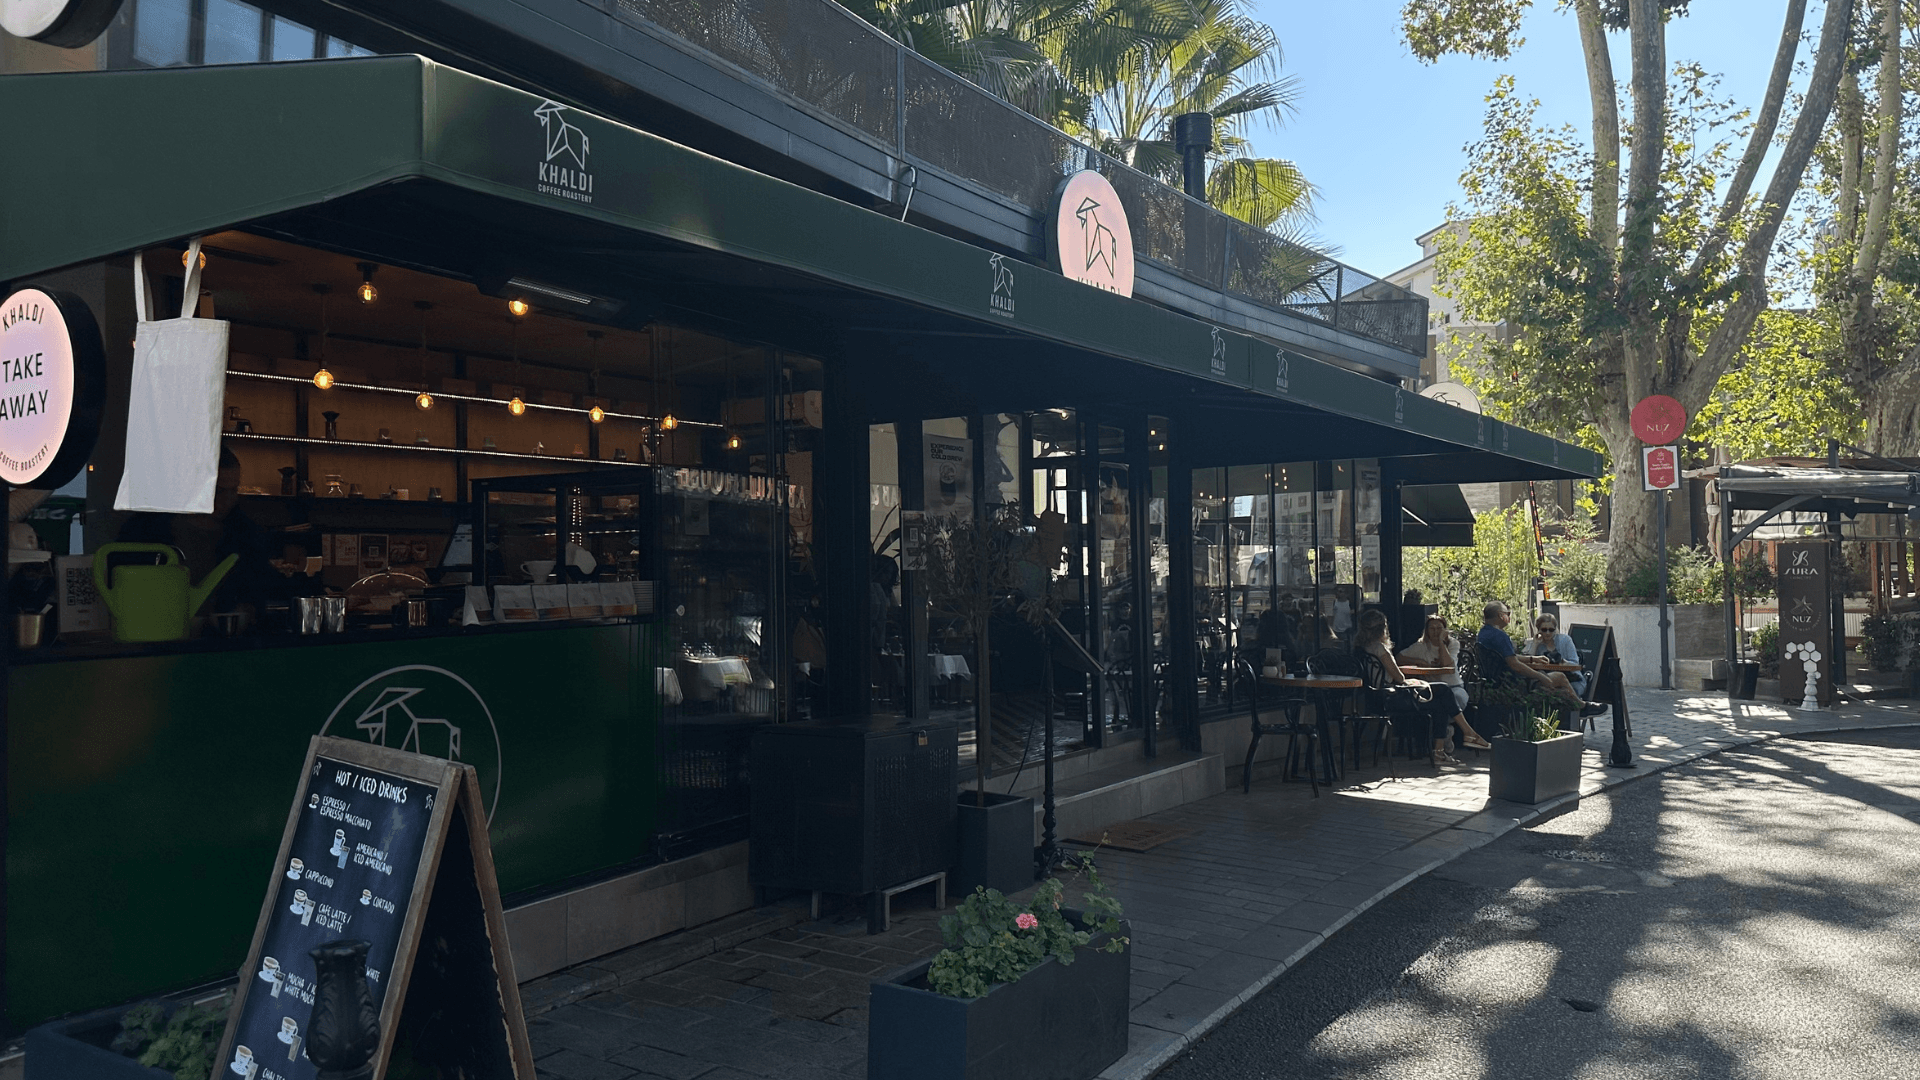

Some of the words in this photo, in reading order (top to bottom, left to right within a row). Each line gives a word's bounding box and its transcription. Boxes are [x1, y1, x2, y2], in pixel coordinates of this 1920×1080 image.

[539, 162, 593, 193] KHALDI
[538, 184, 561, 196] COFFEE
[563, 188, 592, 203] ROASTERY
[991, 294, 1014, 312] KHALDI
[2, 303, 44, 331] KHALDI
[3, 353, 43, 383] TAKE
[0, 389, 48, 420] AWAY
[21, 443, 48, 471] ROASTERY
[931, 443, 964, 452] EXPERIENCE
[335, 770, 352, 786] HOT
[359, 777, 377, 794] ICED
[378, 781, 408, 803] DRINKS
[322, 796, 346, 811] ESPRESSO
[320, 806, 343, 821] ESPRESSO
[344, 813, 372, 830] MACCHIATO
[356, 842, 384, 860] AMERICANO
[354, 853, 364, 864] ICED
[365, 857, 392, 875] AMERICANO
[305, 869, 334, 888] CAPPUCCINO
[373, 896, 395, 914] CORTADO
[315, 914, 327, 926] ICED
[327, 919, 343, 933] LATTE
[331, 909, 347, 923] LATTE
[284, 983, 300, 998] WHITE
[300, 990, 315, 1006] MOCH
